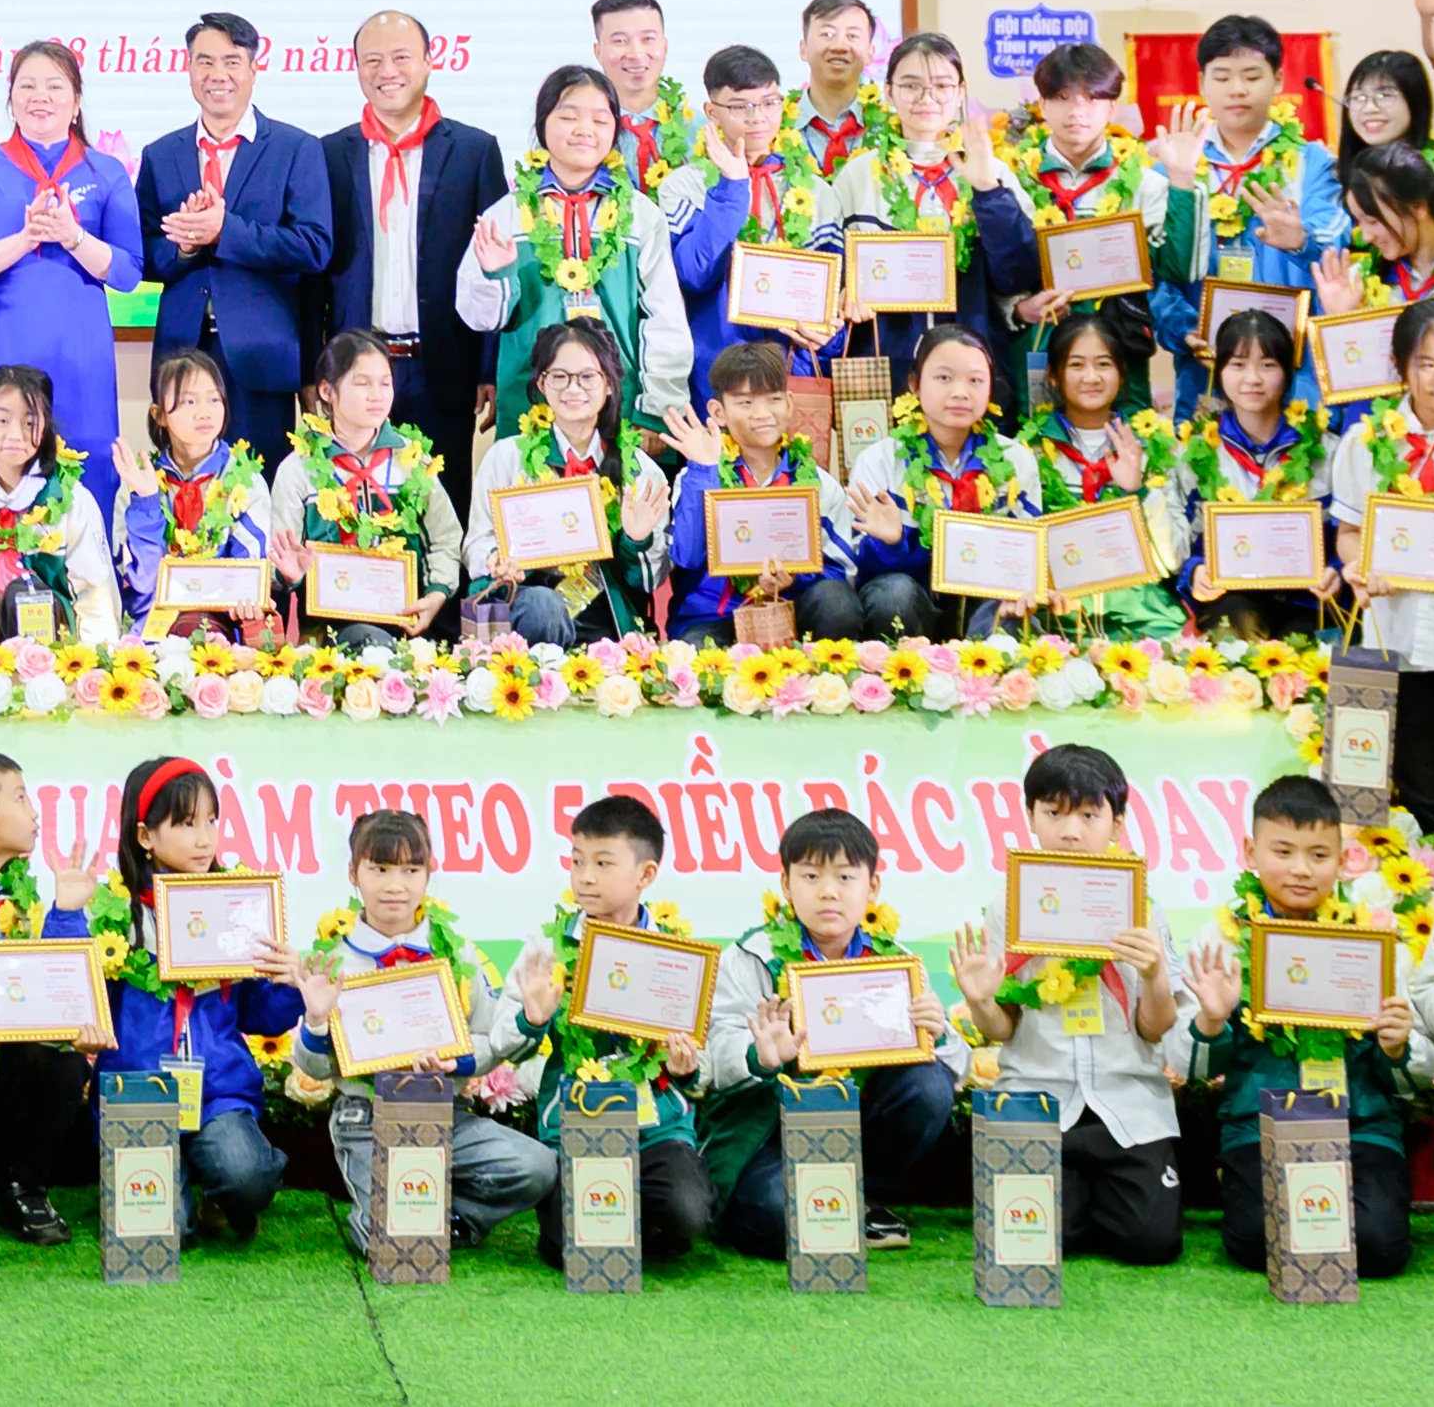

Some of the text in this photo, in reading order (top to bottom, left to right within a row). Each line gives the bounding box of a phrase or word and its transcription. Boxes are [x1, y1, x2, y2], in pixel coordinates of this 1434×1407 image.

[994, 14, 1019, 37] HỘI
[1063, 15, 1088, 39] ĐỘI
[98, 36, 189, 73] thán
